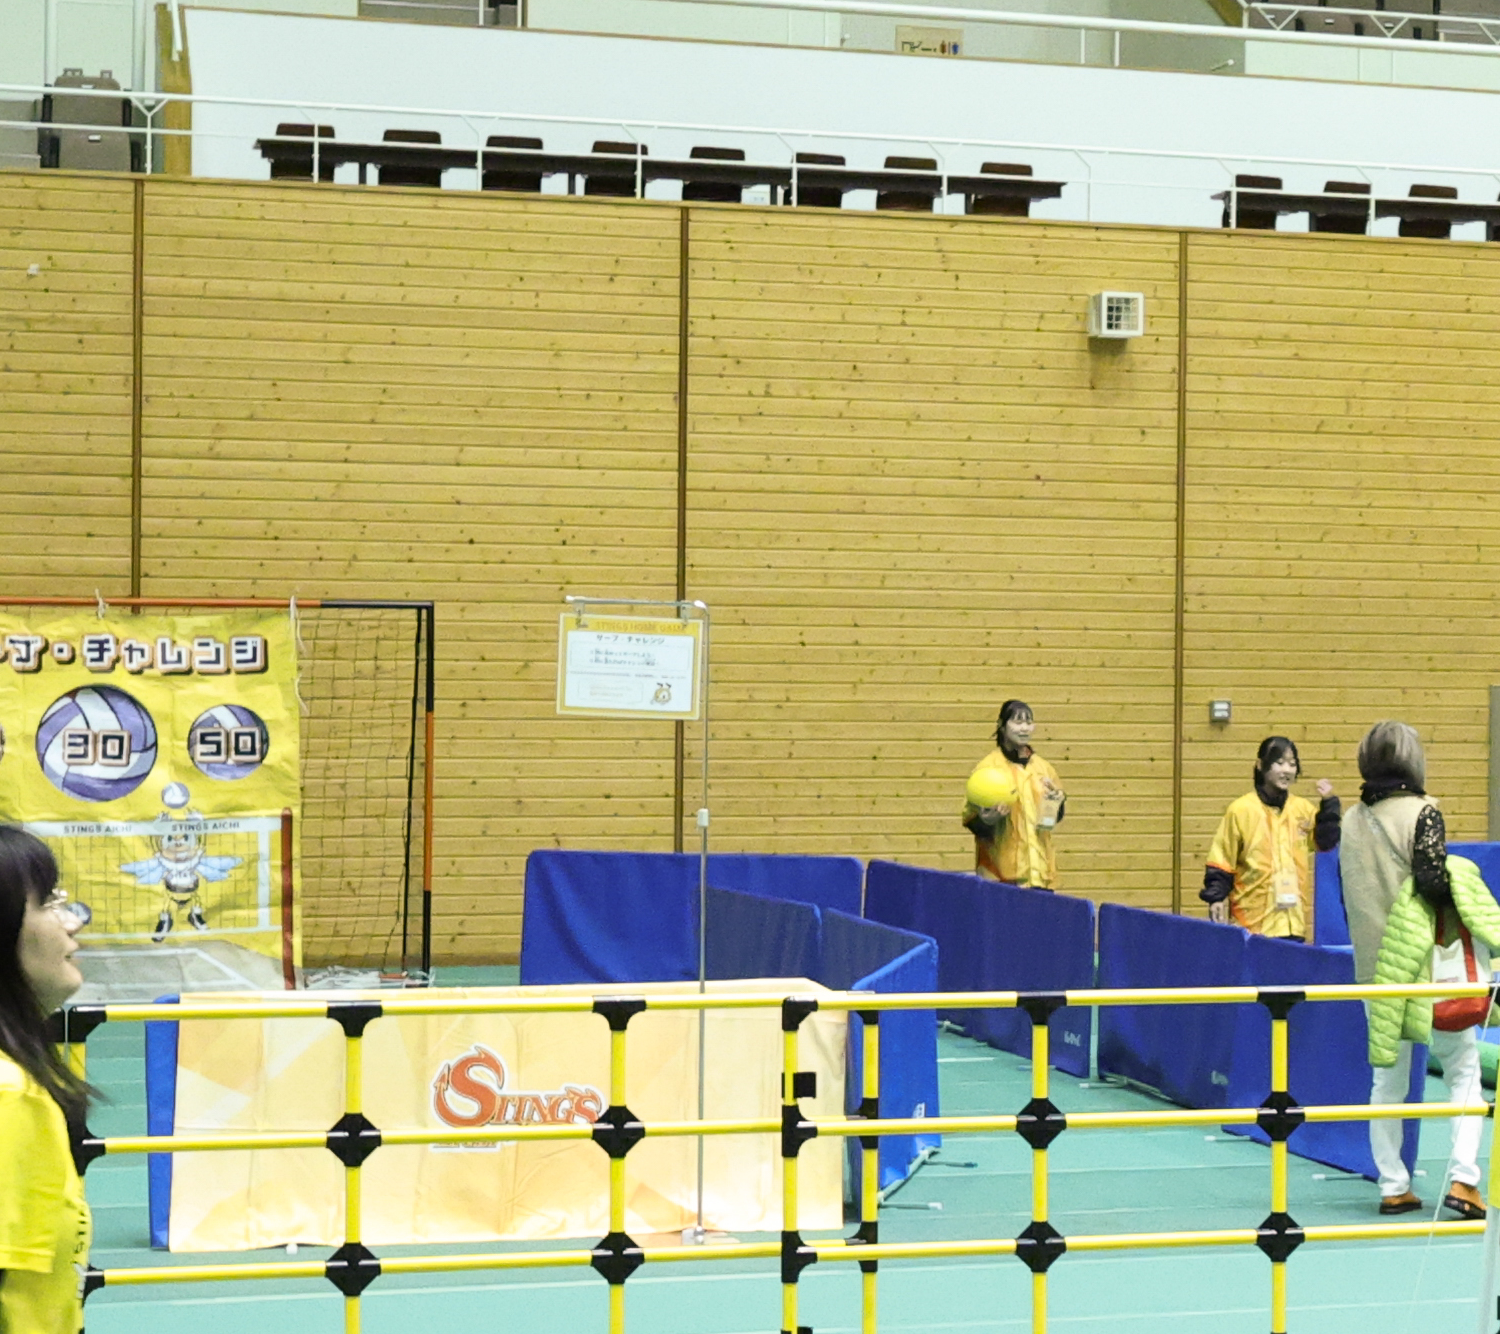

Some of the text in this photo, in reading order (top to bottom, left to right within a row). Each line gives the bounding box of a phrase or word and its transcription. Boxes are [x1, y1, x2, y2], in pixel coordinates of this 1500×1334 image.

[63, 728, 131, 767] 30
[193, 726, 262, 764] 50
[433, 1044, 602, 1127] STINGS
